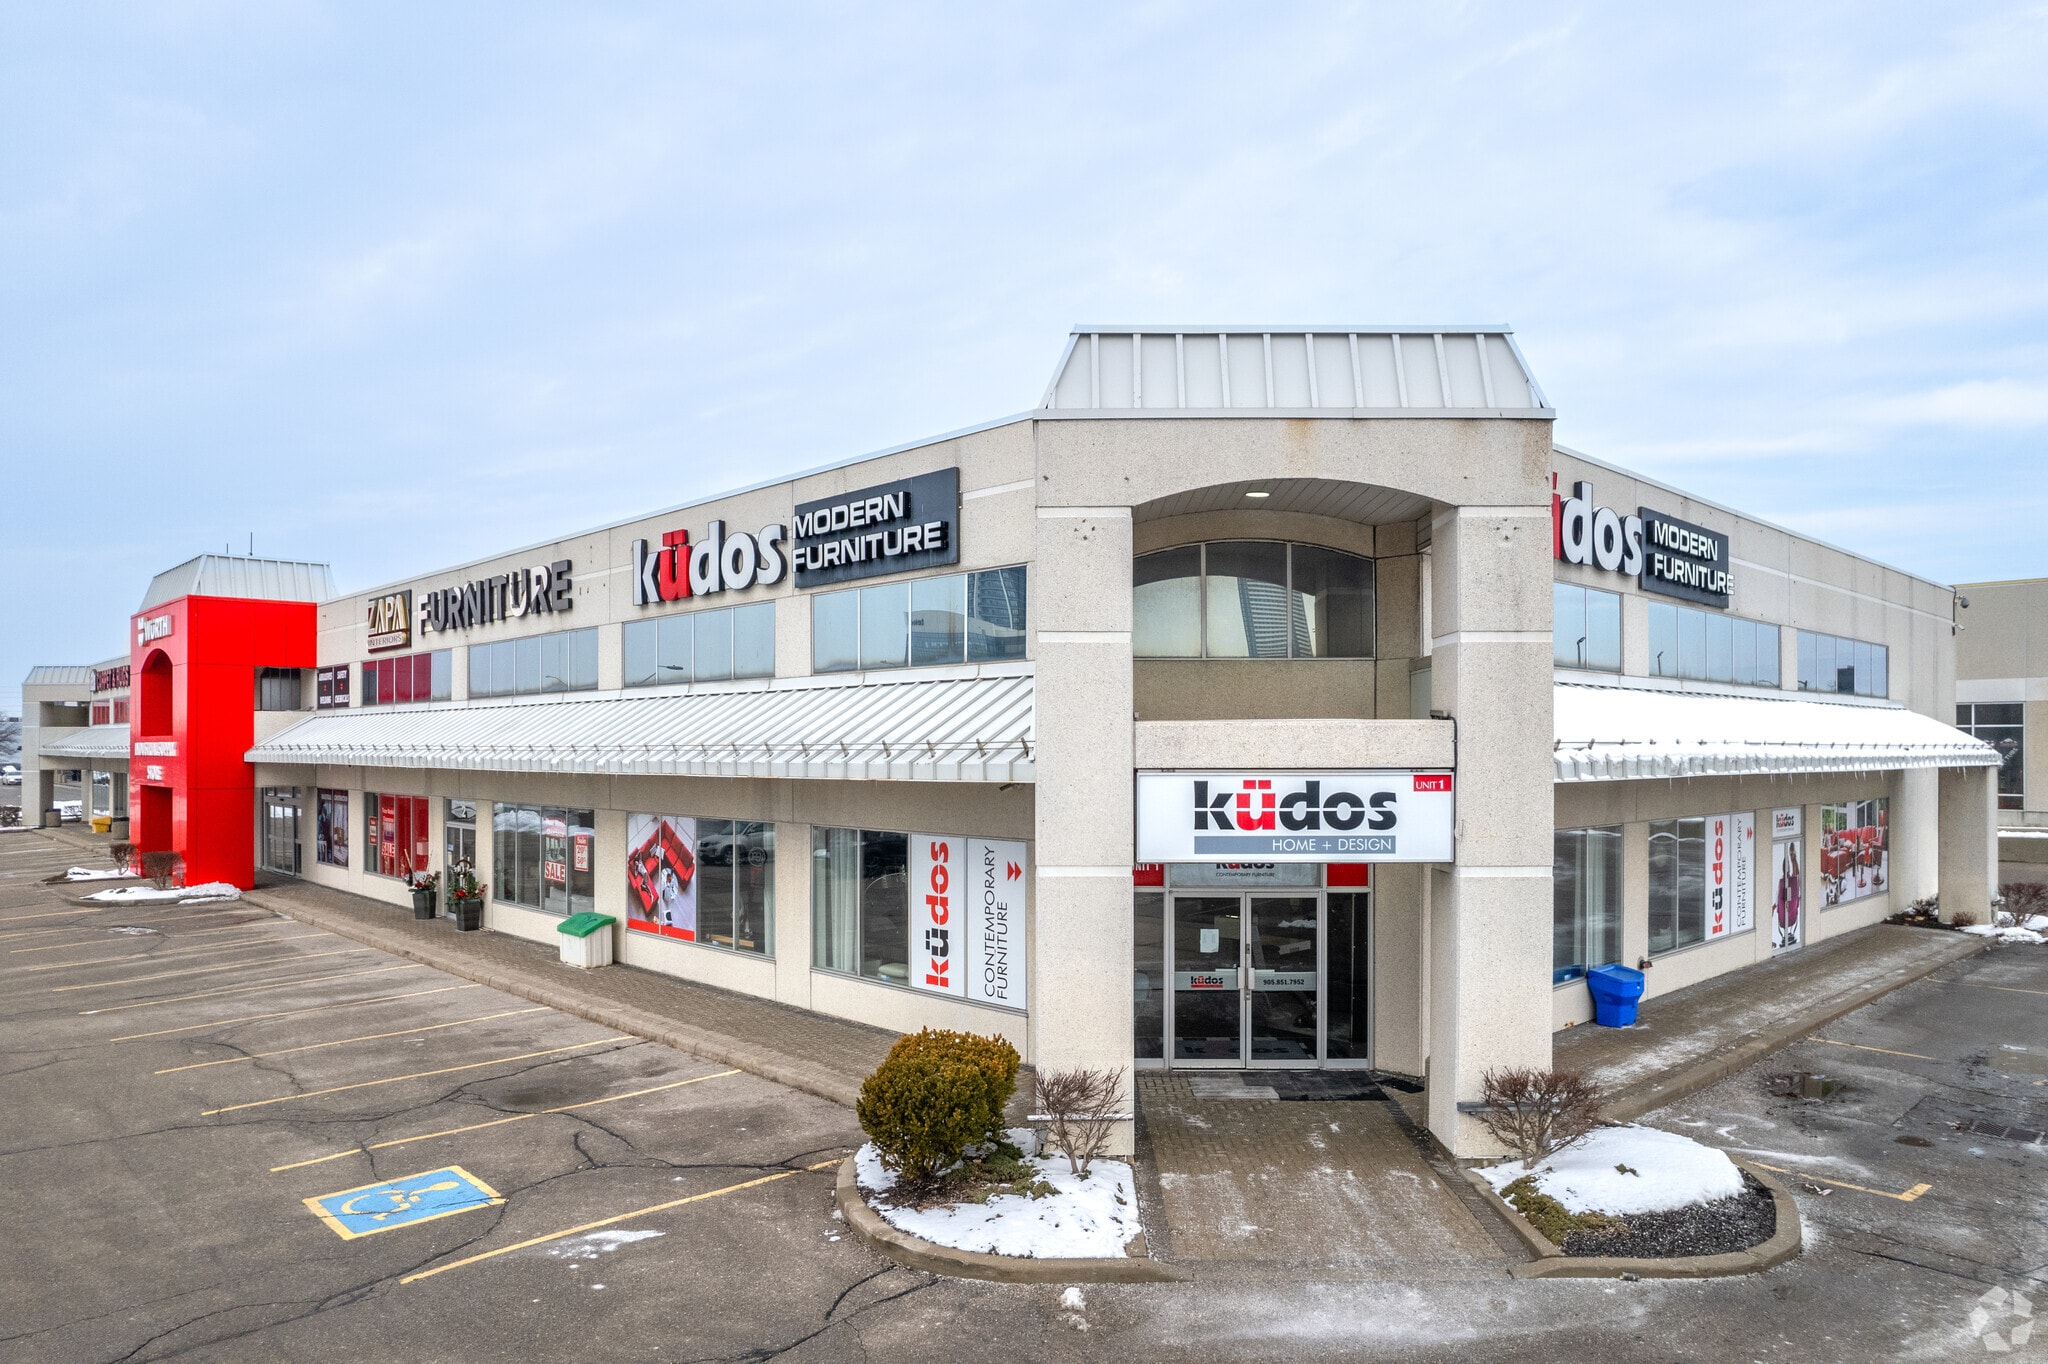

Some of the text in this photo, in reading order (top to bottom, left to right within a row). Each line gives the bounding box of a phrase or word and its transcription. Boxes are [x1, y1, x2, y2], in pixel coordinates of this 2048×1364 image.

[793, 491, 907, 539] MODERN
[1553, 471, 1642, 576] dos
[1653, 519, 1718, 561] MODERN
[632, 520, 787, 606] küdos
[792, 520, 945, 573] FURNITURE
[418, 559, 571, 636] FURNITURE
[1653, 552, 1735, 595] FURNITURE
[368, 594, 406, 635] ZAPA
[1193, 779, 1398, 831] küdos
[1415, 779, 1444, 790] UNIT 1
[1272, 838, 1316, 851] HOME
[1338, 838, 1392, 851] DESIGN
[545, 862, 565, 881] SALE
[1712, 820, 1723, 934] küdos
[925, 841, 949, 988] küdos
[984, 845, 996, 997] CONTEMPORARY
[997, 901, 1008, 1000] FURNITURE
